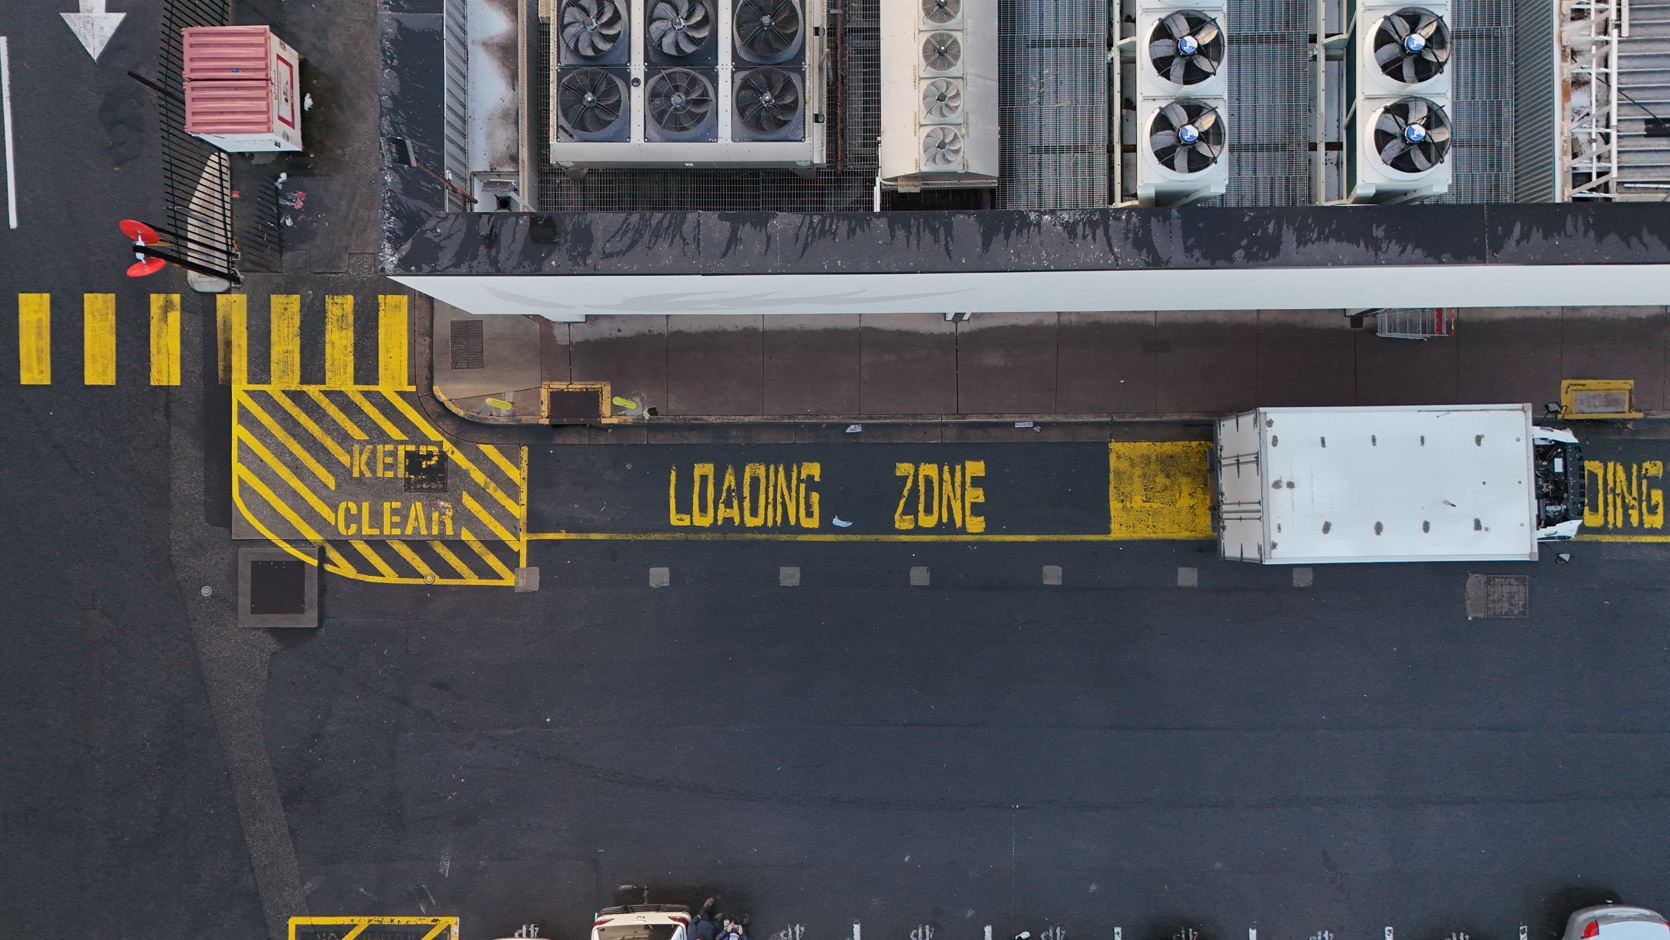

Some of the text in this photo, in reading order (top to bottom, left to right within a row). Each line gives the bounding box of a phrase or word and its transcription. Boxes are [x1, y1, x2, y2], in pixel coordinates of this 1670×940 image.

[337, 501, 454, 535] CLEAR
[669, 460, 986, 533] LOADING ZONE
